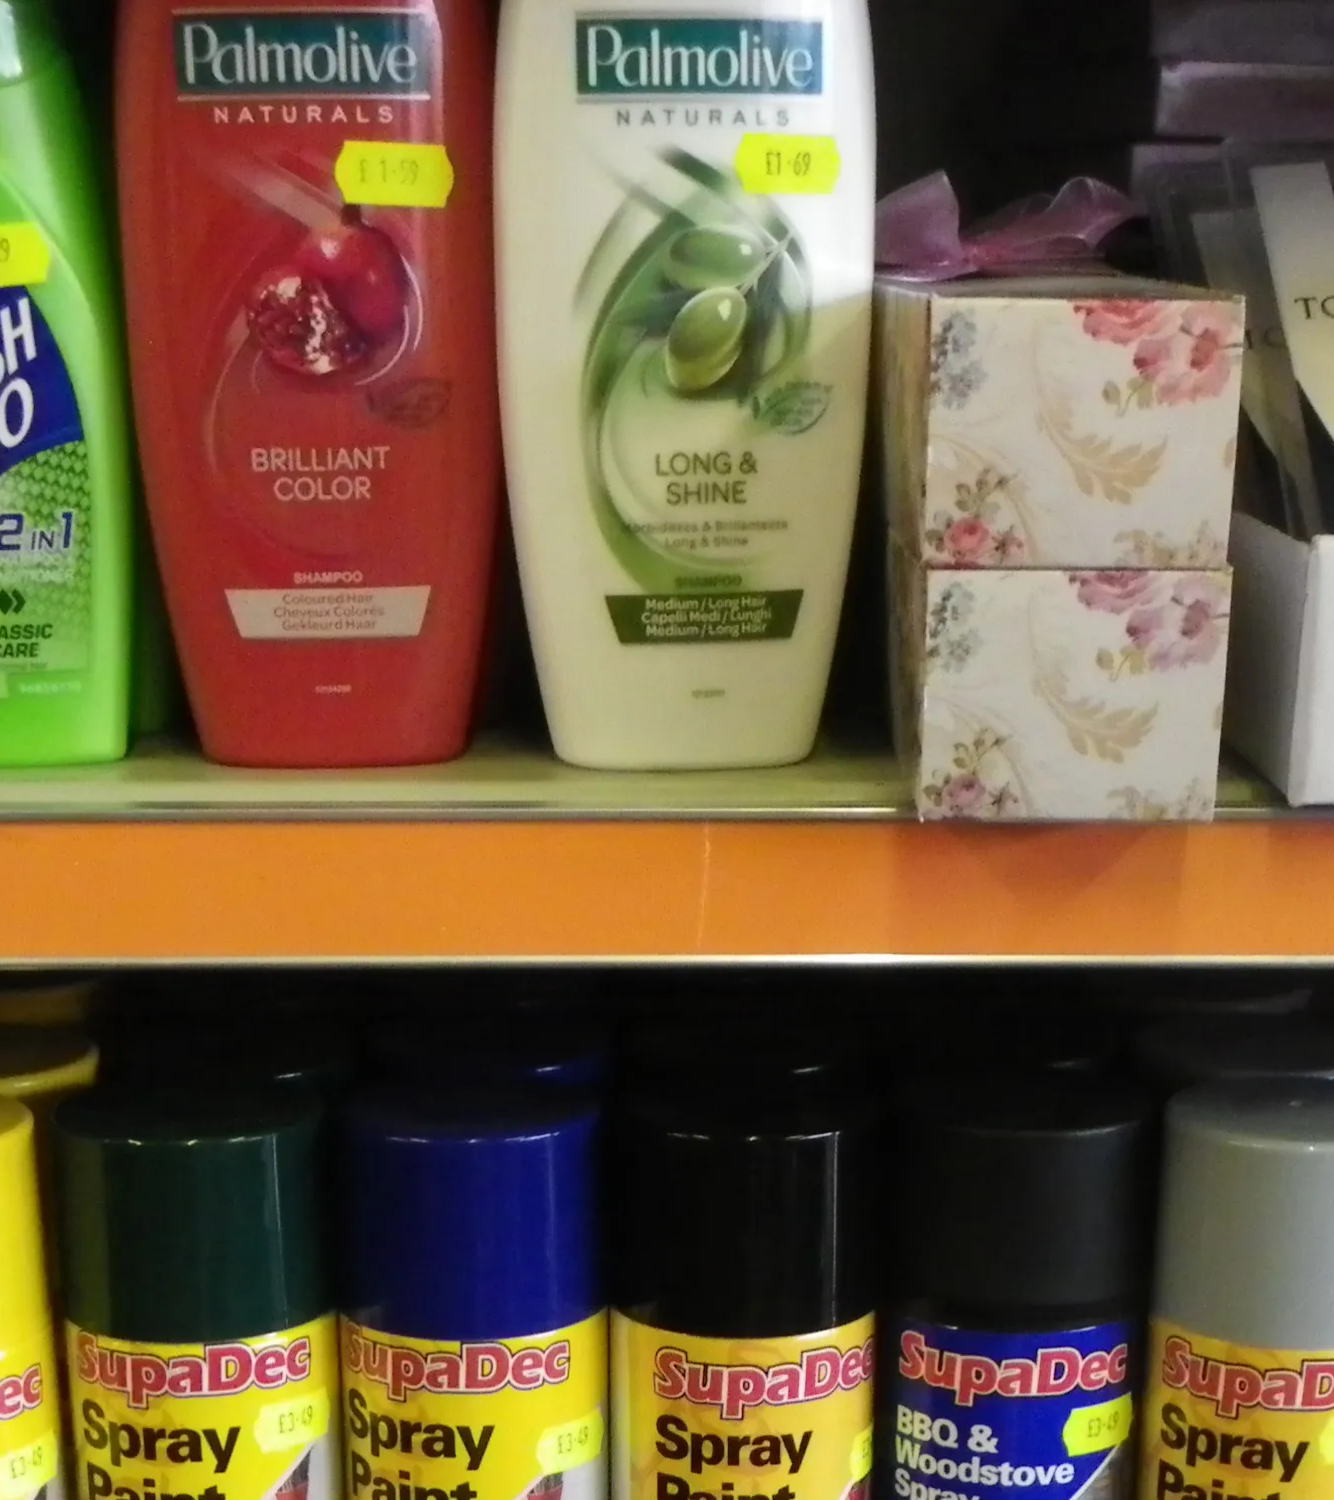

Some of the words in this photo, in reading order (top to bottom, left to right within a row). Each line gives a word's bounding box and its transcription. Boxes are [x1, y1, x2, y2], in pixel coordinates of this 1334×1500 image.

[182, 24, 417, 84] Palmolive
[588, 26, 813, 87] Palmolive
[215, 106, 394, 123] NATURALS
[616, 109, 790, 127] NATURALS
[250, 447, 390, 472] BRILLIANT
[655, 452, 731, 477] LONG
[740, 452, 758, 473] &
[273, 476, 371, 500] COLOR
[666, 481, 747, 505] SHINE
[31, 531, 54, 551] IN
[61, 512, 73, 551] 1
[293, 571, 363, 584] SHAMPOO
[76, 1332, 310, 1410] SupaDec
[899, 1330, 1128, 1408] SupaDec
[81, 1398, 241, 1474] Spray
[349, 1388, 495, 1471] Spray
[655, 1414, 813, 1475] Spray
[897, 1404, 959, 1448] BBQ
[1160, 1401, 1310, 1483] Spray
[895, 1436, 1075, 1488] Woodstove
